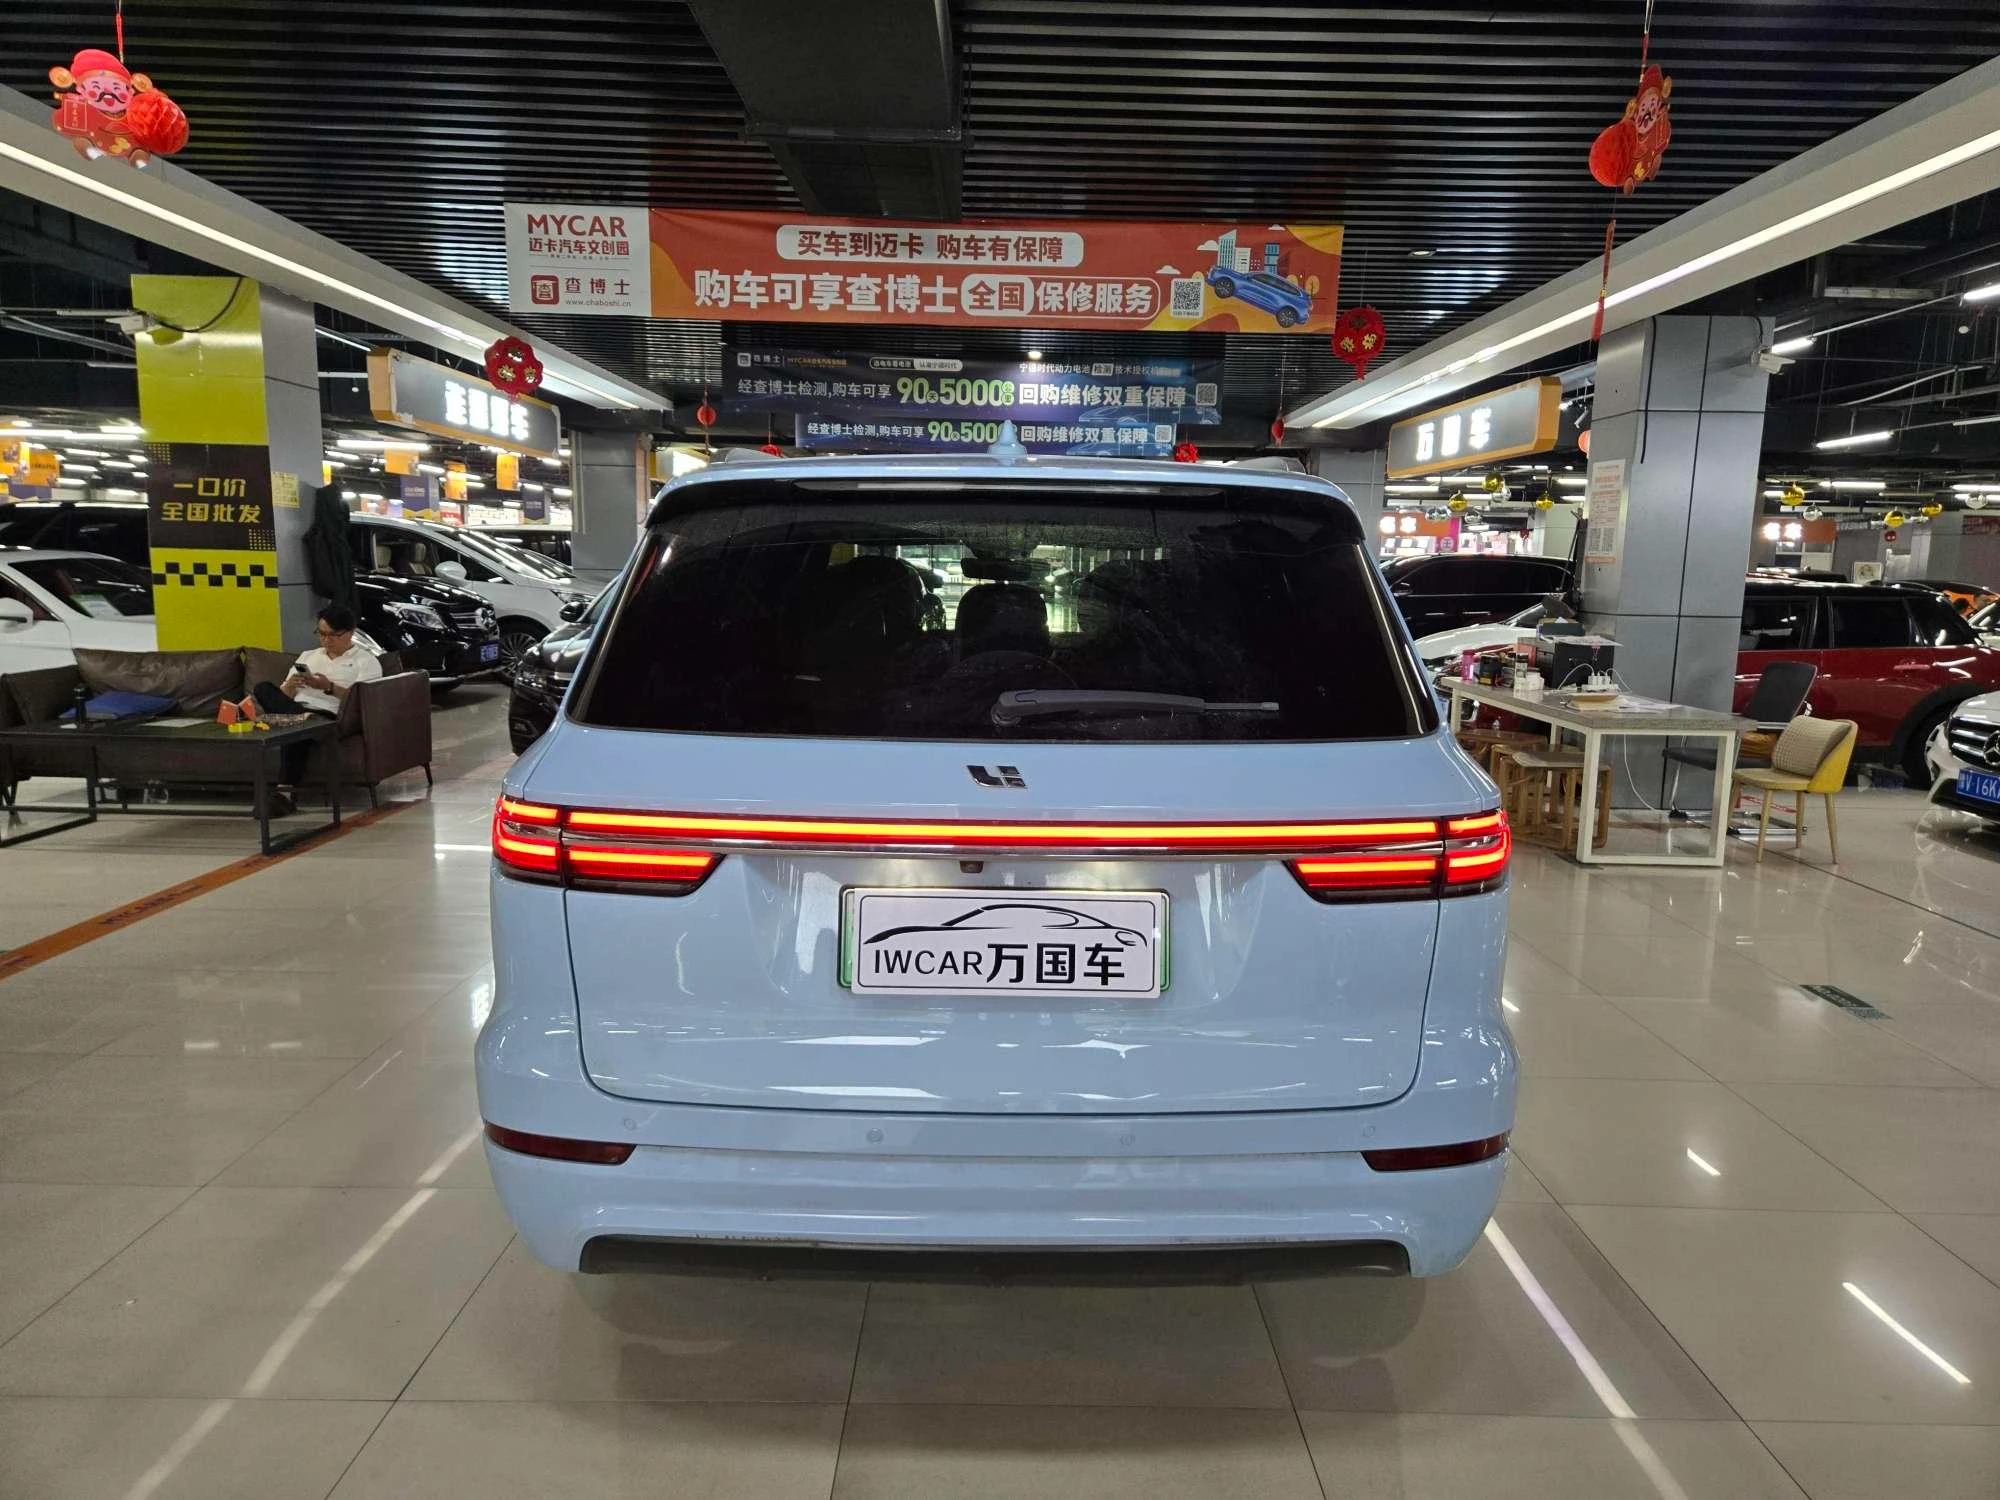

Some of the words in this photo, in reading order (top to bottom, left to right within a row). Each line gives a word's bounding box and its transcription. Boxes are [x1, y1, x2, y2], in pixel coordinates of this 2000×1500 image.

[527, 213, 627, 237] MYCAR
[529, 237, 630, 256] 迈卡汽车文创园
[797, 230, 924, 259] 买车到迈卡
[936, 233, 1063, 263] 购车有保障
[564, 276, 631, 296] 查博士
[1018, 382, 1186, 408] 回购维修双重保障
[1020, 425, 1148, 445] 回购维修双重保障
[173, 477, 246, 498] 一口价
[161, 501, 262, 524] 全国批发
